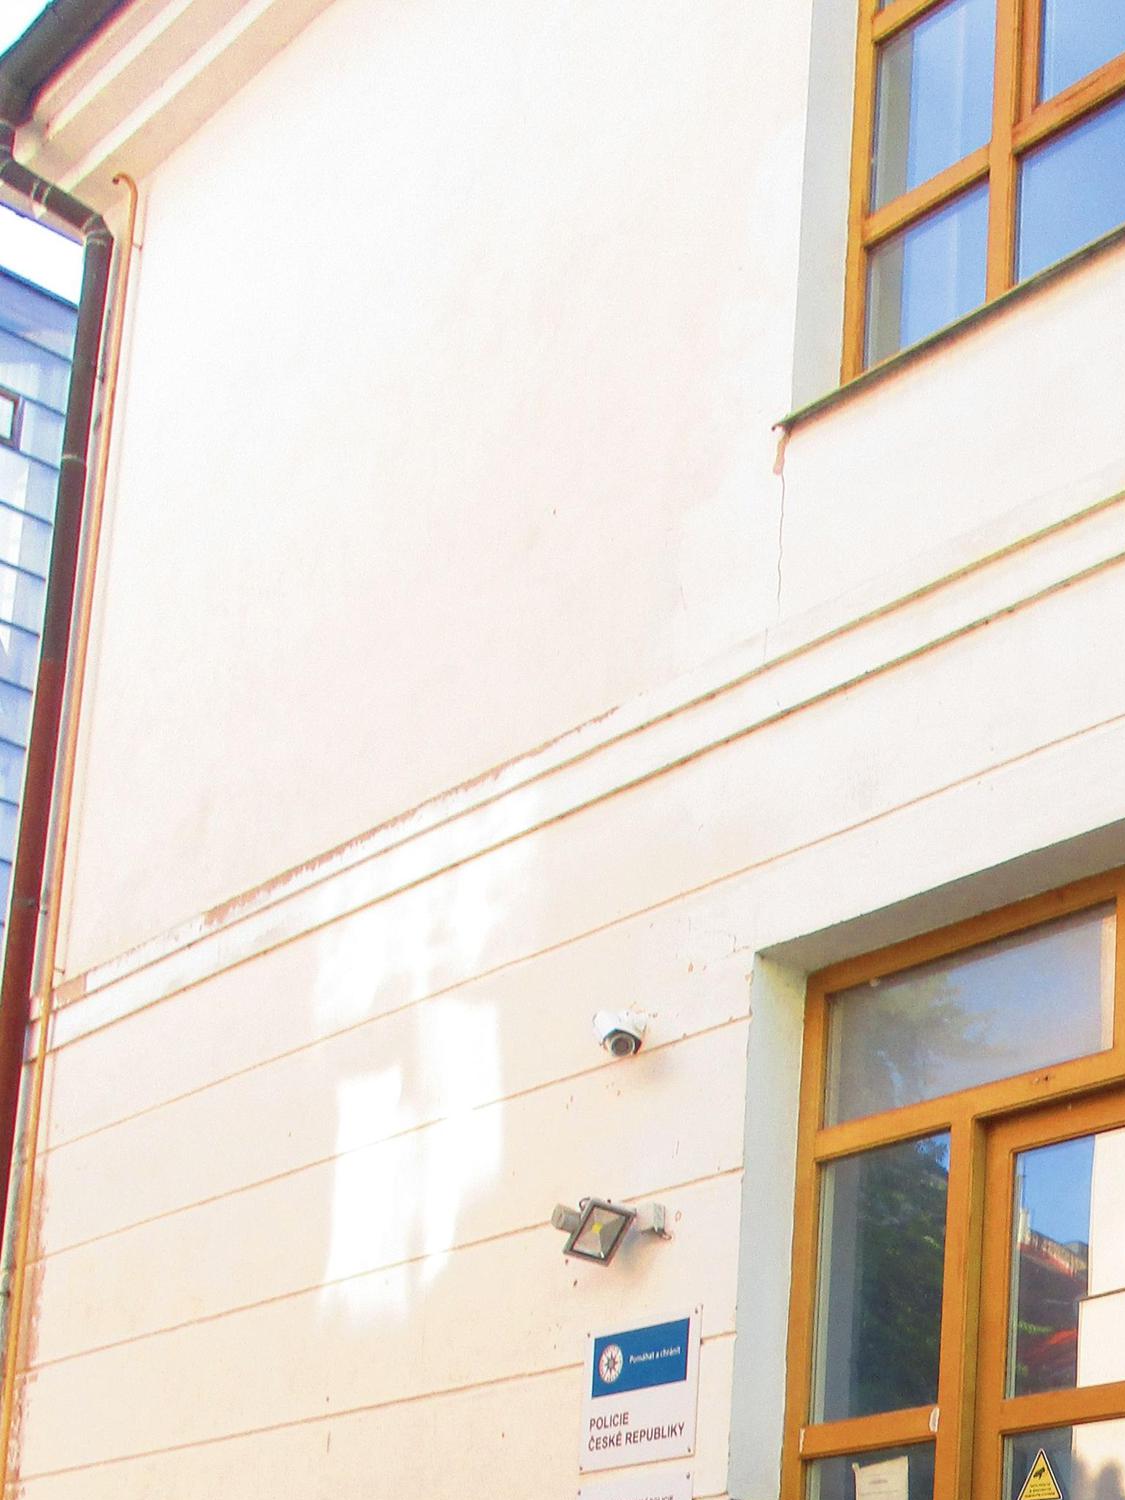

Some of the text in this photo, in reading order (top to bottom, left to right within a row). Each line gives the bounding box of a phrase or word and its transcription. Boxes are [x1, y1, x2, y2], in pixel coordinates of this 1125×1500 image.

[589, 1411, 629, 1432] POLICIE
[588, 1421, 685, 1452] ČESKÉ REPUBLIKY
